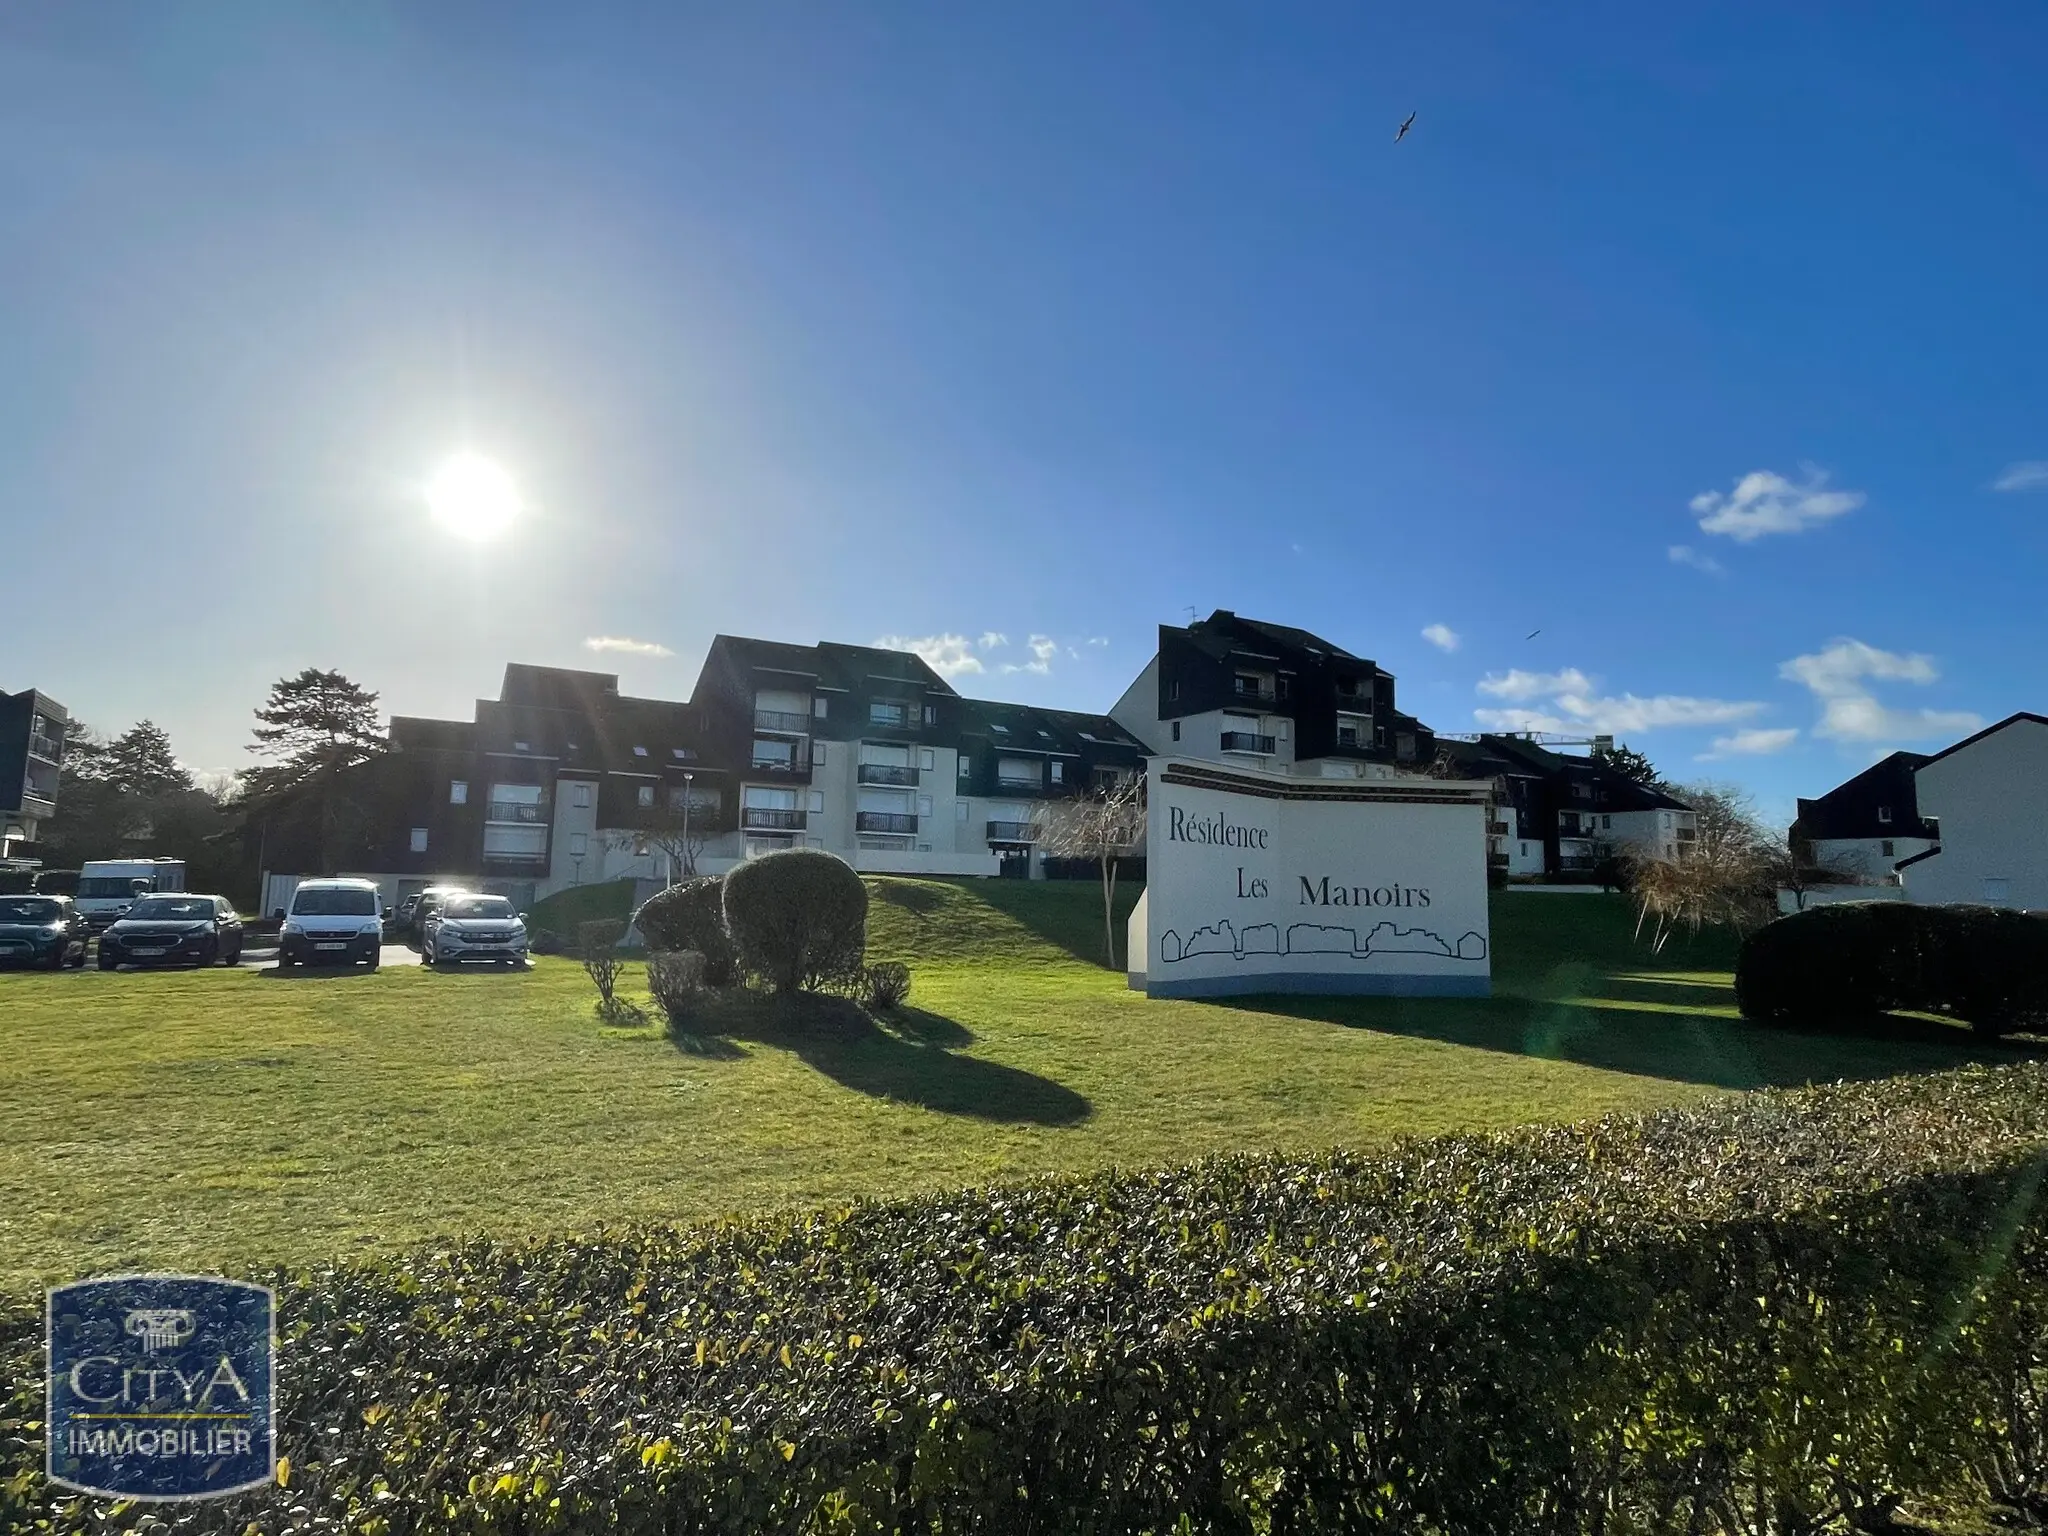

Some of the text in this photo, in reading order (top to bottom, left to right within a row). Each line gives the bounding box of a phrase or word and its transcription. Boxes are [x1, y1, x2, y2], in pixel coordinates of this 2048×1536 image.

[1168, 805, 1269, 850] Résidence
[1236, 867, 1431, 908] Les Manoirs
